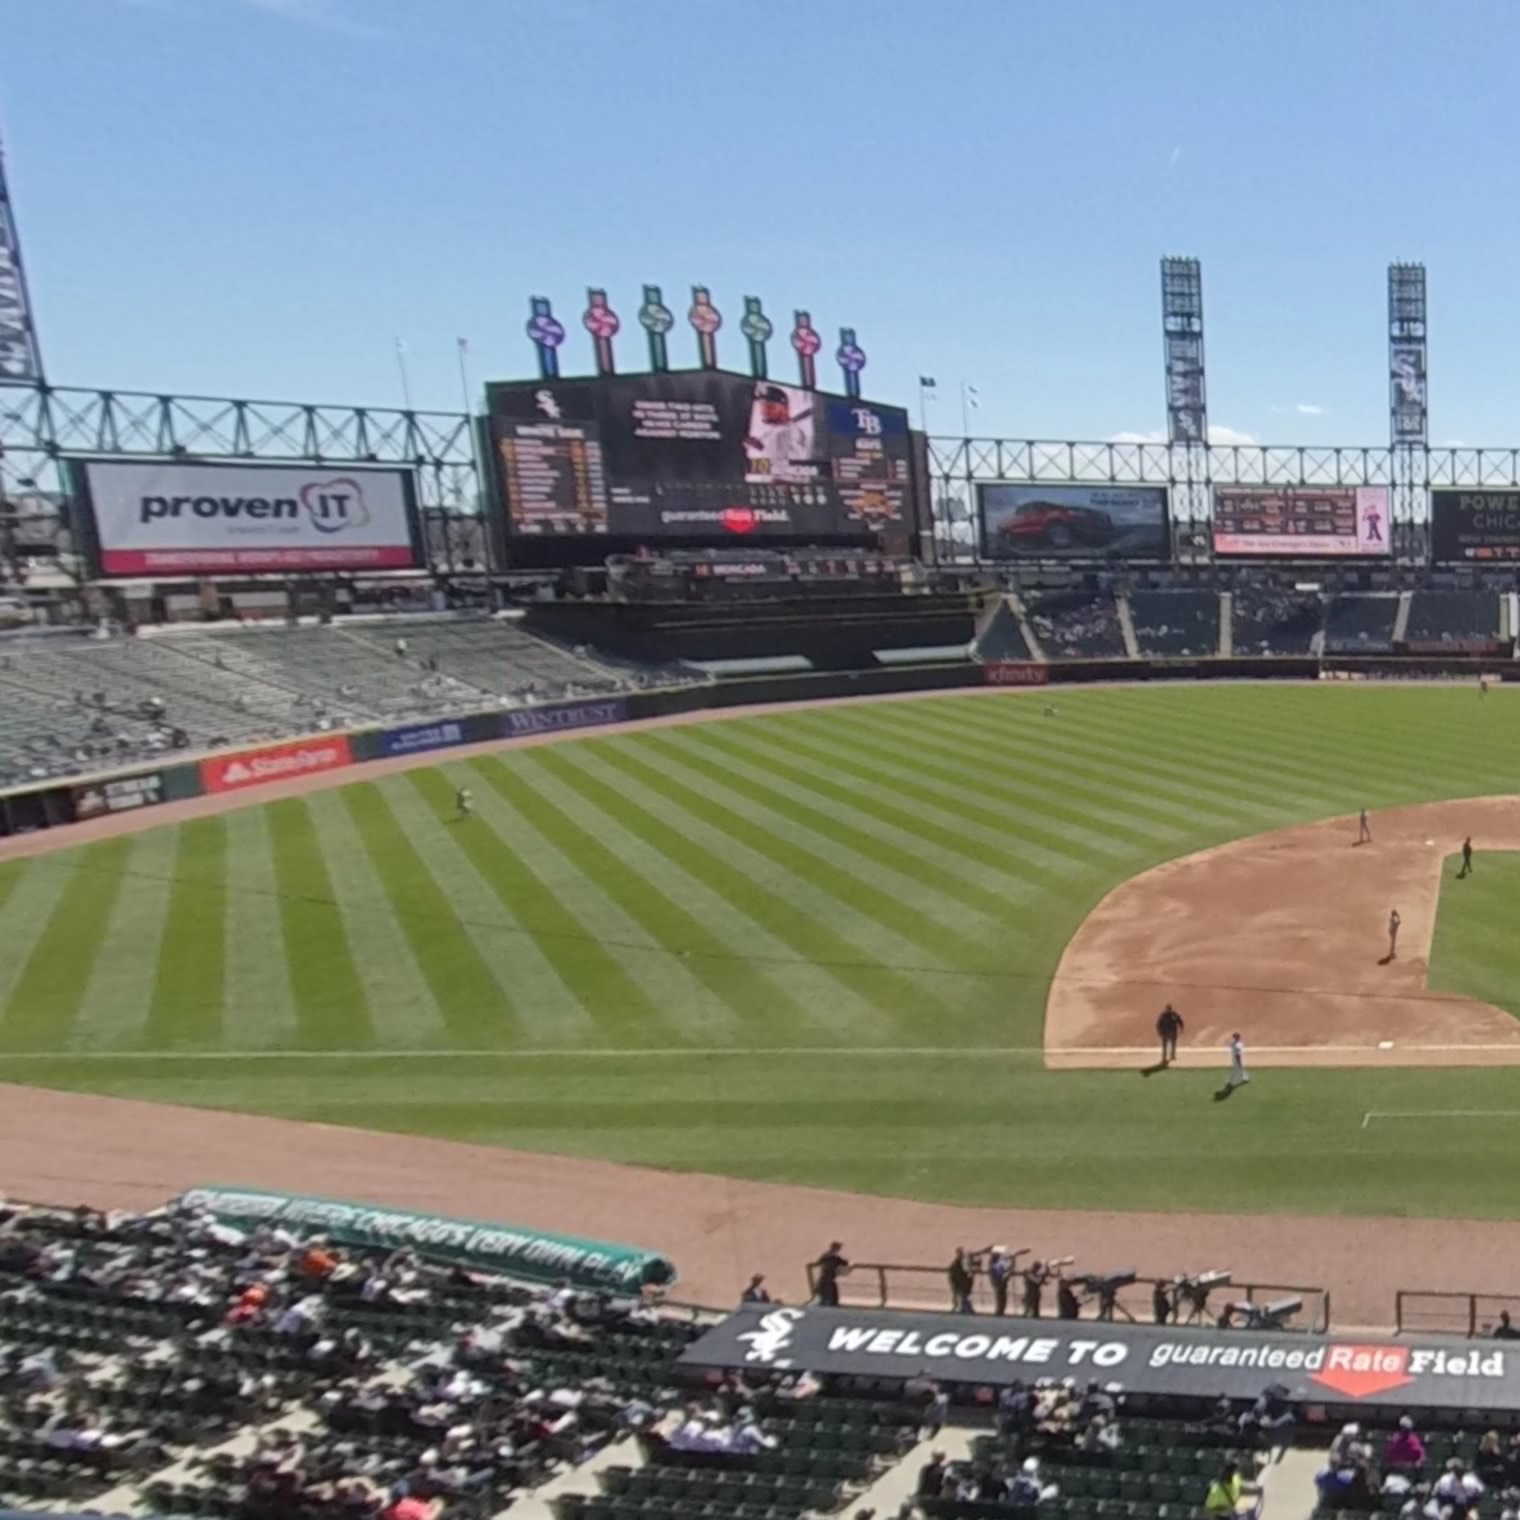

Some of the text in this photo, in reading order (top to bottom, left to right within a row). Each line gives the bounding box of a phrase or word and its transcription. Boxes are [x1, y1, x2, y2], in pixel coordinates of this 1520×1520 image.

[140, 494, 350, 523] proven IT
[988, 667, 1042, 683] xfinity
[509, 703, 617, 729] WINTRUST
[353, 1210, 474, 1247] CHICAGO'S
[465, 1229, 532, 1256] VERY
[827, 1326, 1060, 1363] WELCOME
[1066, 1341, 1129, 1366] TO
[1149, 1343, 1326, 1372] guaranteed
[1329, 1349, 1400, 1373] Rate
[1409, 1350, 1504, 1377] Field
